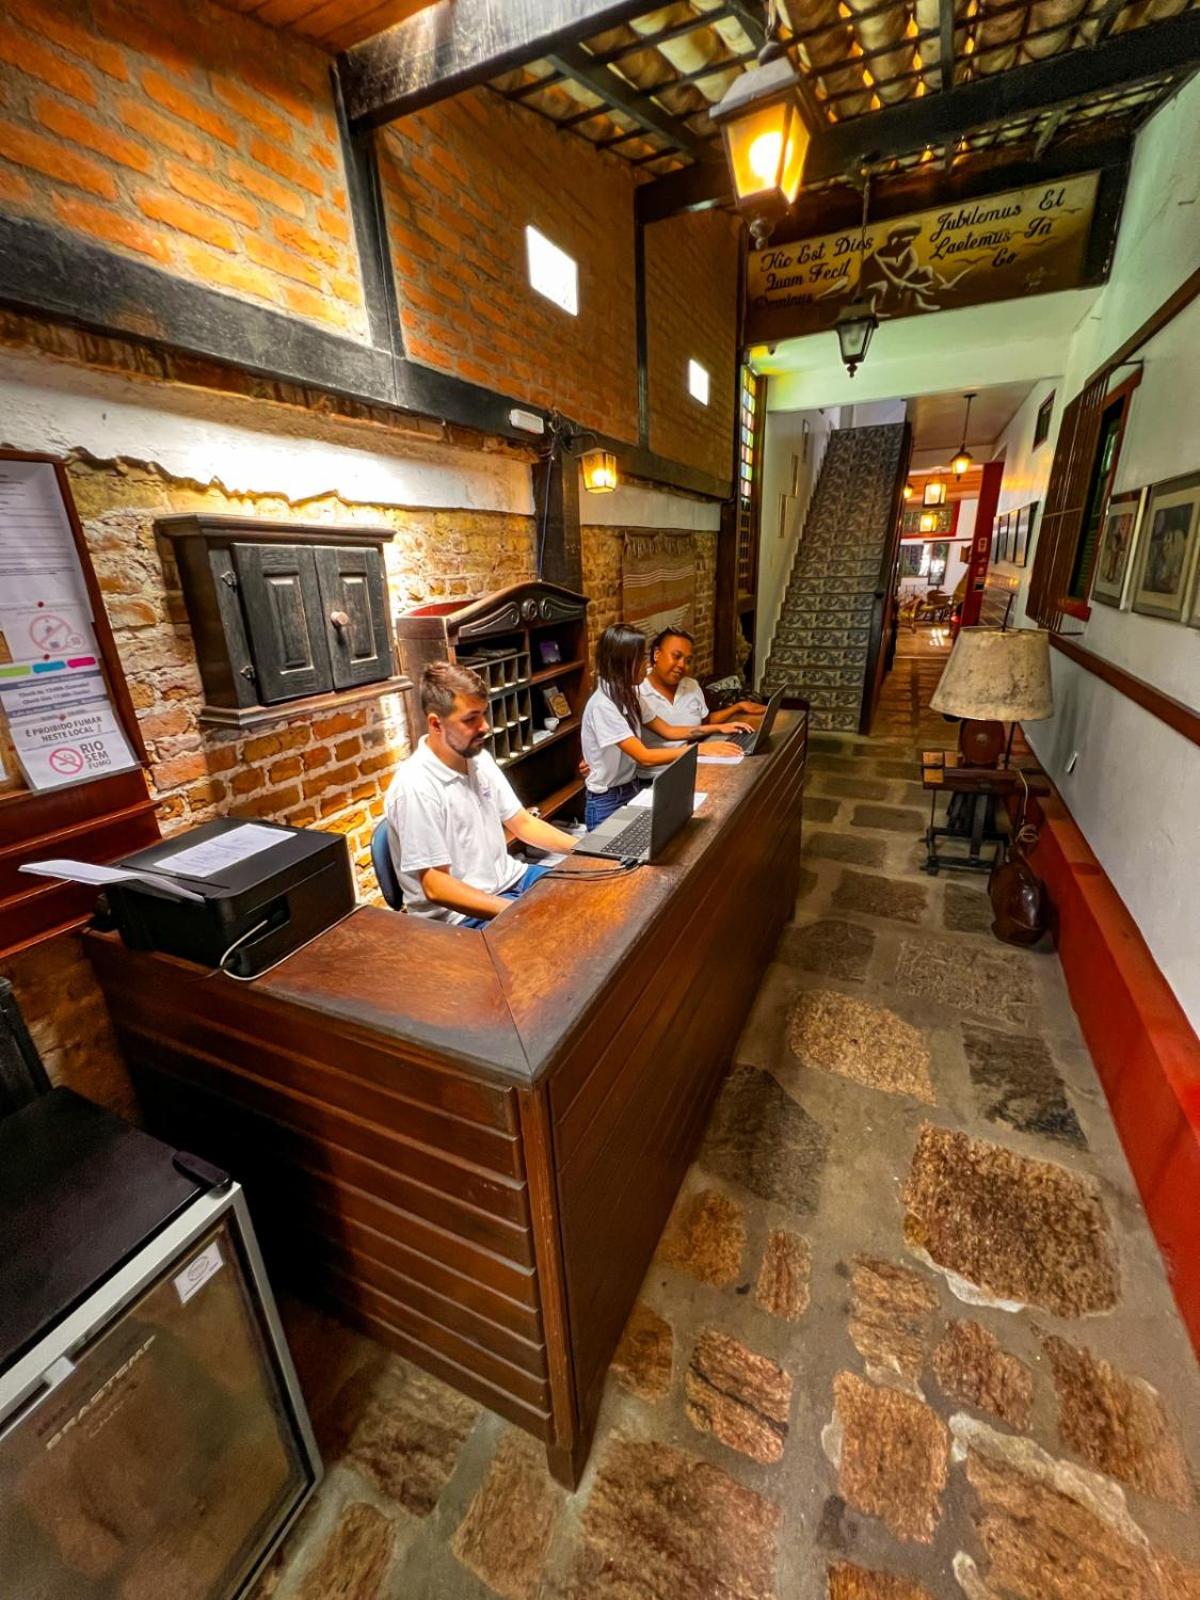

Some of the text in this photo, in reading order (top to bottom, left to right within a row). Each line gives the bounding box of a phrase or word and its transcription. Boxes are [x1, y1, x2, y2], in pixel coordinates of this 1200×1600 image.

[33, 721, 73, 737] PROIBIDO
[74, 715, 102, 728] FUMAR
[41, 725, 94, 743] NESTE LOCAL
[80, 740, 104, 755] RIO
[84, 750, 109, 763] SEM
[88, 759, 112, 770] FUMO
